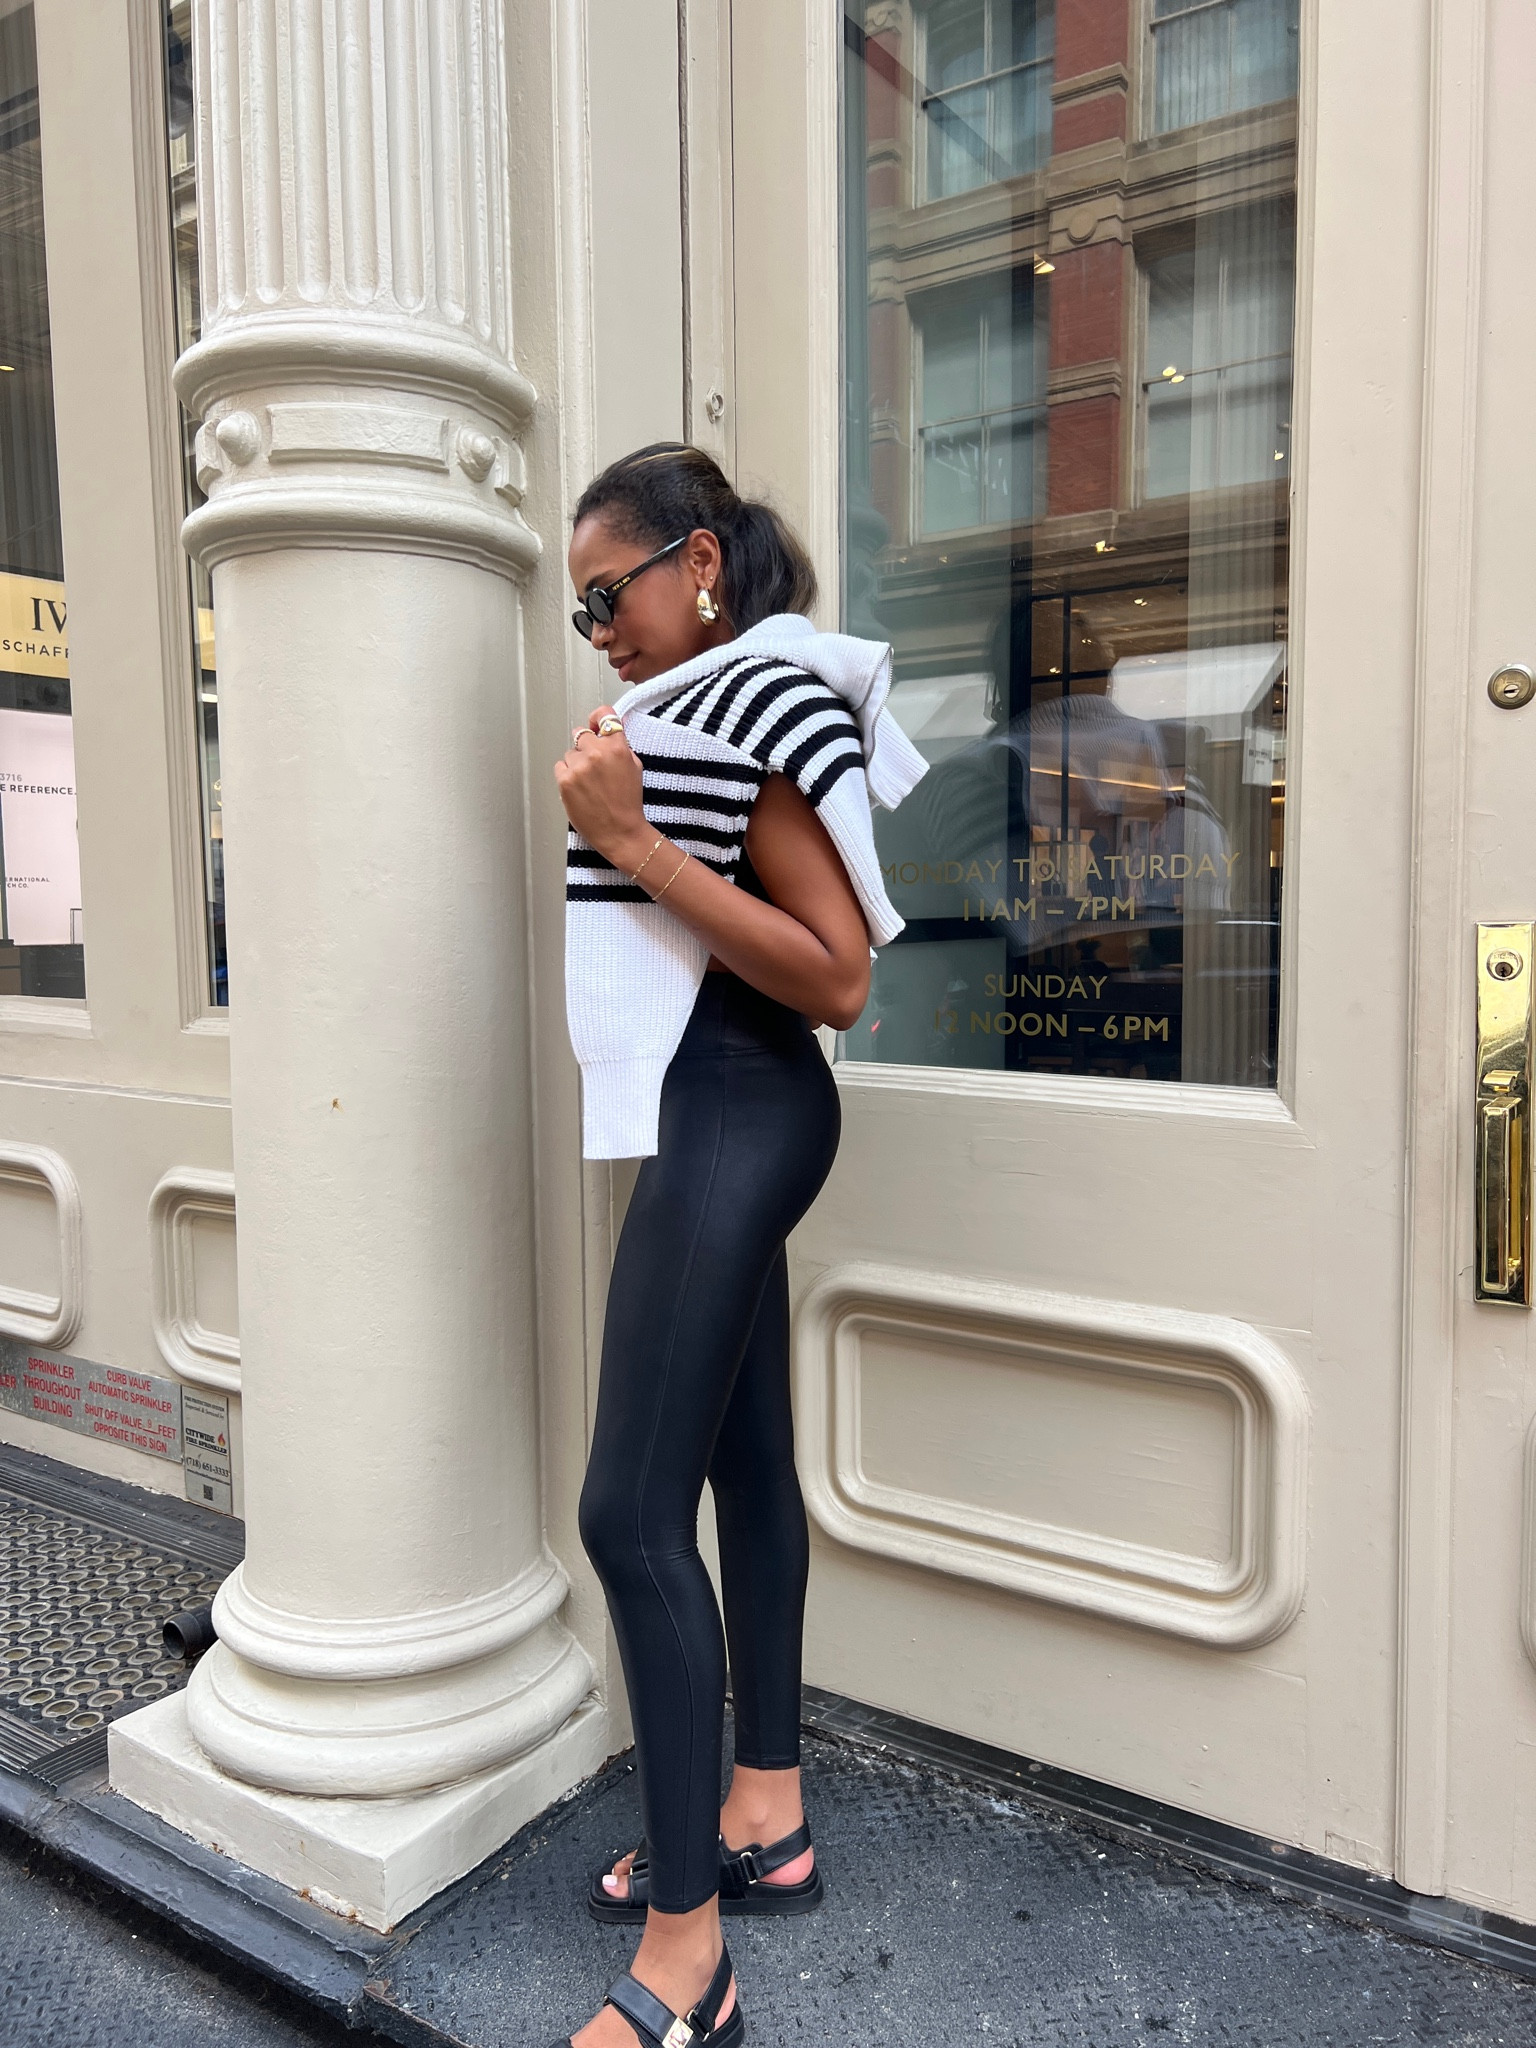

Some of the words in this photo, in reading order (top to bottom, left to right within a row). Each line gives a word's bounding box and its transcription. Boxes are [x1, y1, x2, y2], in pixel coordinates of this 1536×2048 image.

[881, 859, 1002, 885] MONDAY
[1012, 858, 1056, 883] TO
[963, 897, 1036, 922] 11AM
[1074, 896, 1136, 921] 7PM
[984, 973, 1108, 999] SUNDAY
[934, 1009, 959, 1034] 12
[970, 1011, 1068, 1037] NOON
[28, 1356, 75, 1380] SPRINKLER
[107, 1370, 127, 1385] CURB
[128, 1376, 152, 1392] VALVE
[23, 1374, 81, 1400] THROUGHOUT
[88, 1381, 129, 1402] AUTOMATIC
[130, 1393, 172, 1414] SPRINKLER
[33, 1395, 73, 1418] BUILDING
[84, 1403, 104, 1418] SHUT
[104, 1409, 119, 1421] OFF
[94, 1421, 130, 1442] OPPOSITE
[130, 1432, 148, 1447] THIS
[149, 1438, 167, 1453] SIGN
[185, 1427, 216, 1444] CITYWIDE
